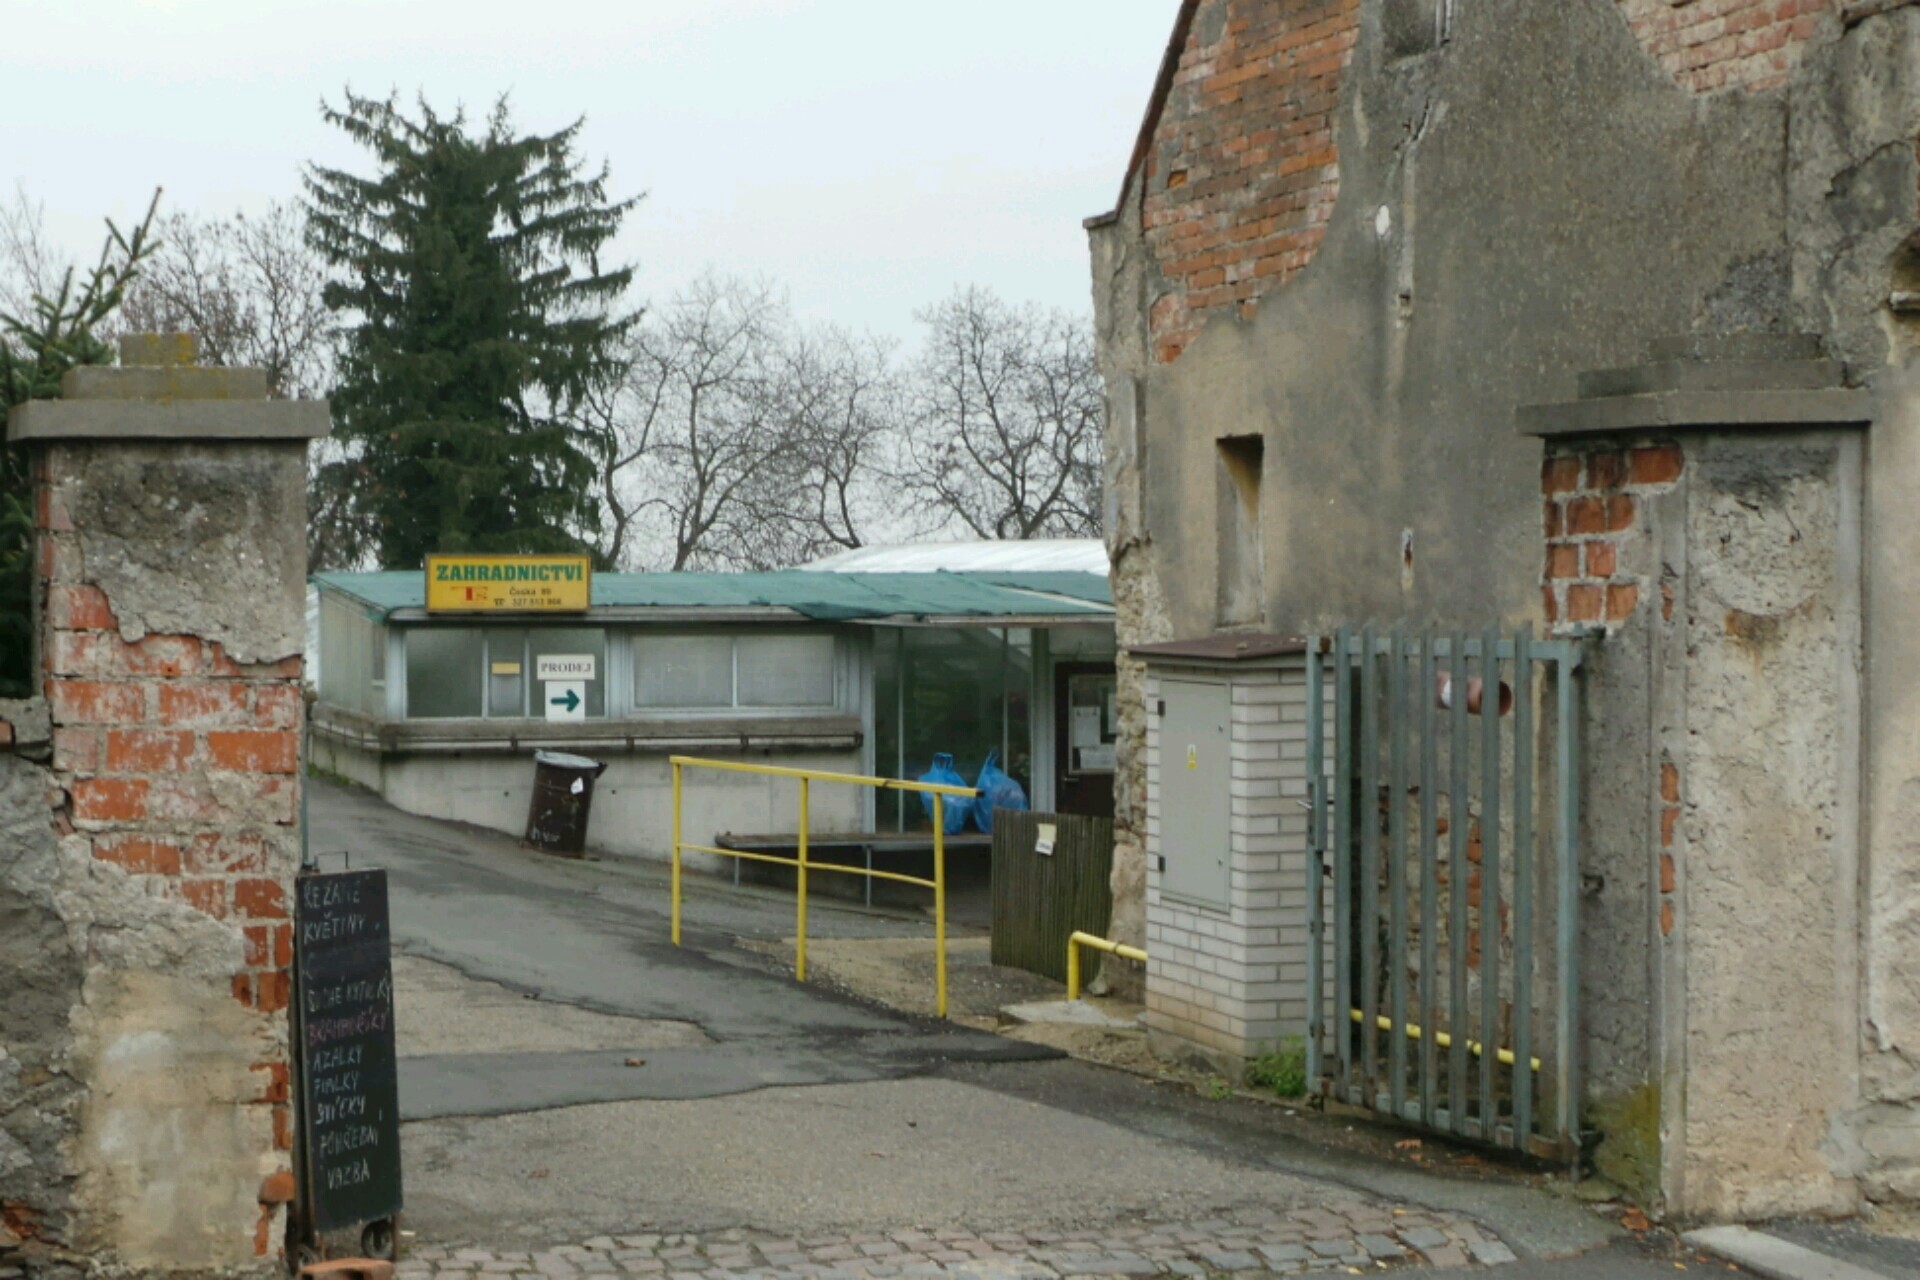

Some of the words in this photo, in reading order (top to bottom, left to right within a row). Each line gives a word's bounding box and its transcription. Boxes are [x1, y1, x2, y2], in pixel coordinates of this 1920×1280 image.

[436, 560, 583, 582] ZAHRADNICTVÍ
[540, 662, 592, 672] PRODEJ
[312, 1044, 363, 1073] AZALKY
[313, 1070, 361, 1097] FIALKY
[327, 1156, 371, 1190] VAZBA
